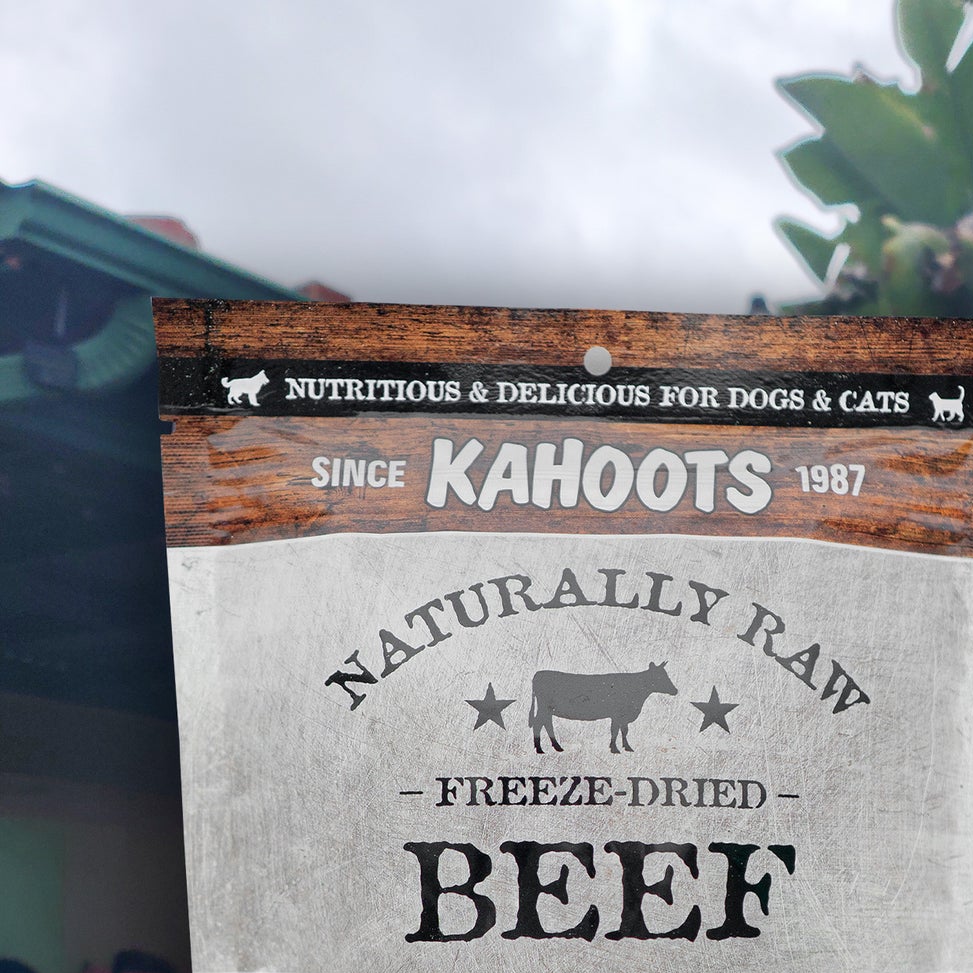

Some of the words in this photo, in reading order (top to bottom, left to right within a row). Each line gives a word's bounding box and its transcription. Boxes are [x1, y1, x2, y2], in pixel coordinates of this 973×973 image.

[284, 377, 461, 403] NUTRITIOUS
[469, 382, 490, 403] &
[496, 382, 651, 408] DELICIOUS
[659, 385, 720, 409] FOR
[727, 387, 805, 412] DOGS
[812, 389, 832, 412] &
[839, 389, 910, 414] CATS
[311, 456, 407, 489] SINCE
[426, 437, 774, 515] KAHOOTS
[795, 463, 866, 497] 1987
[324, 567, 730, 711] NATURALLY
[737, 602, 871, 714] RAW
[434, 776, 768, 809] FREEZE-DRIED
[403, 841, 796, 943] BEEF
